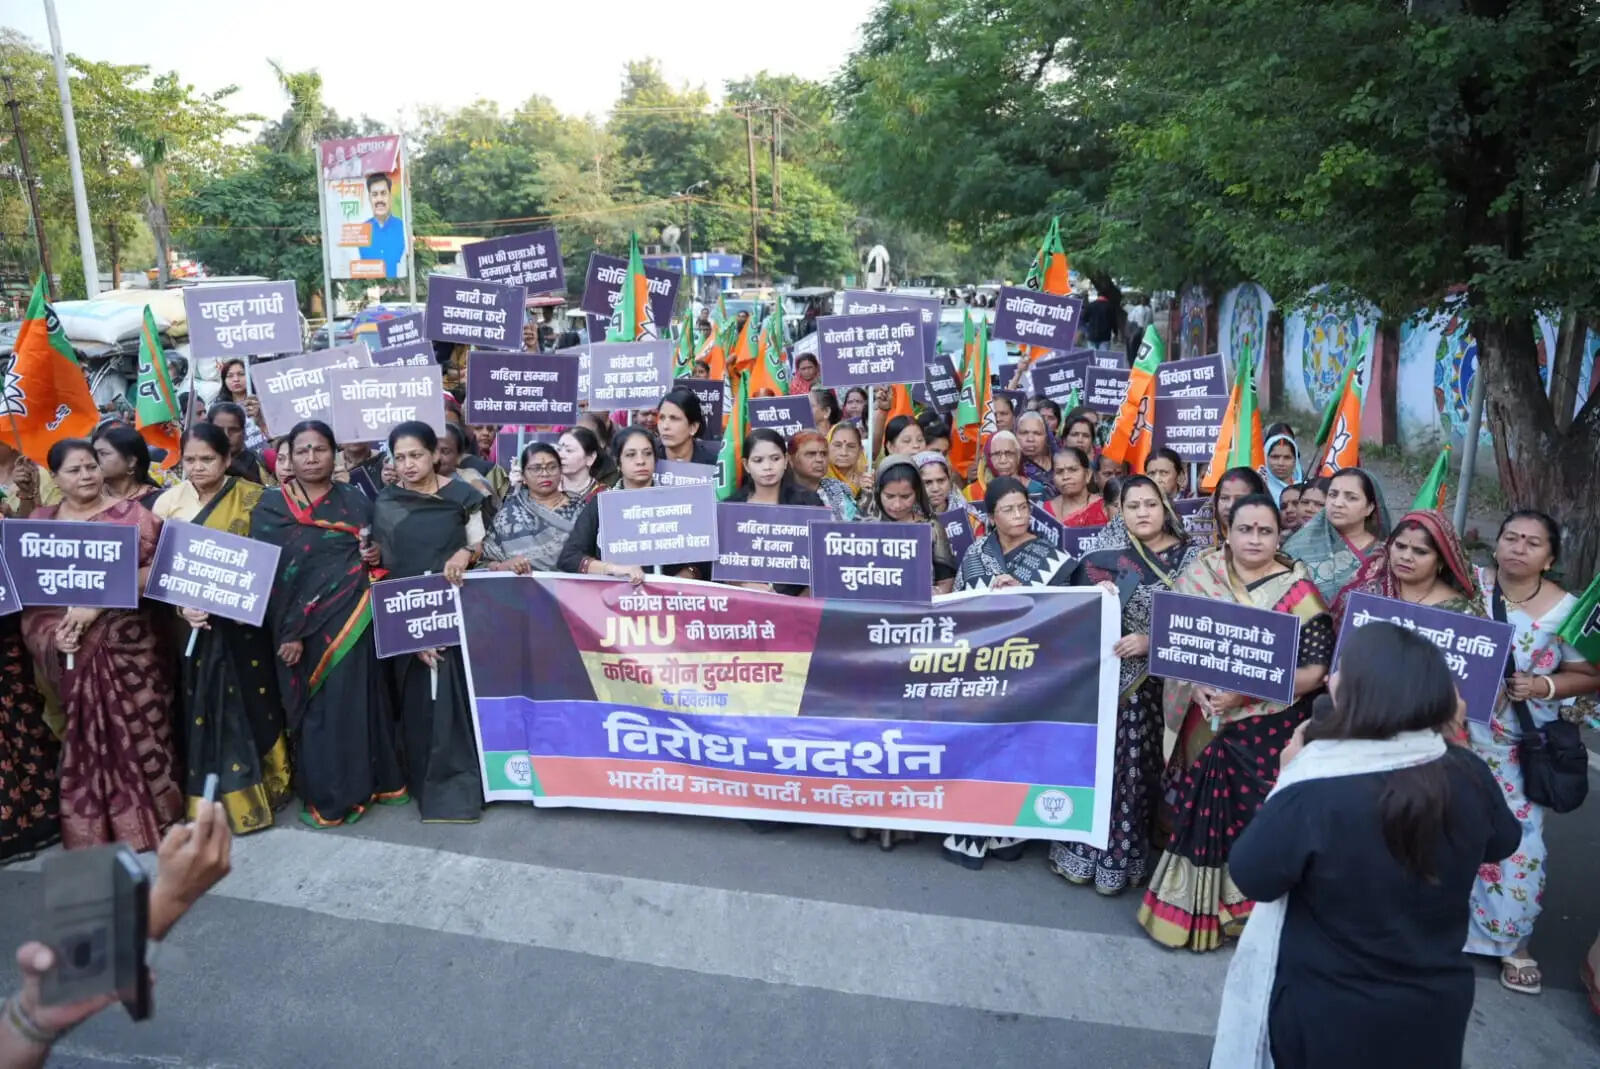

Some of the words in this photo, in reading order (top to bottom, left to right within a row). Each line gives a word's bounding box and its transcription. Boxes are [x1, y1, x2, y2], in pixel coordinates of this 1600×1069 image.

[199, 300, 244, 322] राहुल
[247, 292, 283, 315] गांधी
[456, 289, 480, 304] नारी
[482, 293, 497, 306] का
[1006, 296, 1046, 318] सोनिया
[1047, 304, 1074, 322] गांधी
[442, 305, 483, 321] सम्मान
[485, 308, 507, 324] करो
[214, 320, 275, 348] मुर्दाबाद
[441, 322, 482, 338] सम्मान
[484, 325, 506, 340] करो
[824, 328, 855, 344] बोलती
[856, 326, 865, 341] है
[865, 324, 889, 340] नारी
[891, 323, 916, 339] शक्ति
[1016, 318, 1056, 338] मुर्दाबाद
[837, 347, 853, 359] अब
[854, 342, 876, 357] नहीं
[490, 367, 522, 381] महिला
[523, 371, 559, 382] सम्मान
[848, 360, 870, 375] नहीं
[870, 358, 894, 373] सहेंगे
[1159, 368, 1191, 386] प्रियंका
[1192, 366, 1215, 381] वाड्रा
[266, 367, 324, 394] सोनिया
[341, 378, 397, 401] सोनिया
[399, 376, 433, 398] गांधी
[504, 383, 515, 397] में
[516, 386, 544, 397] हमला
[473, 397, 503, 411] कांग्रेस
[504, 400, 517, 411] का
[519, 398, 548, 412] असली
[549, 399, 573, 412] चेहरा
[756, 406, 778, 421] नारी
[779, 408, 790, 420] का
[1177, 405, 1202, 420] नारी
[1203, 408, 1218, 420] का
[361, 403, 416, 430] मुर्दाबाद
[1165, 425, 1206, 437] सम्मान
[622, 505, 653, 520] महिला
[655, 504, 692, 517] सम्मान
[638, 520, 649, 534] में
[650, 521, 679, 533] हमला
[736, 520, 770, 535] महिला
[771, 524, 809, 537] सम्मान
[19, 532, 81, 560] प्रियंका
[83, 539, 122, 564] वाड्रा
[609, 540, 637, 554] कांग्रेस
[640, 540, 653, 551] का
[654, 535, 685, 550] असली
[687, 534, 710, 547] चेहरा
[752, 536, 764, 551] में
[764, 541, 794, 552] हमला
[825, 532, 879, 558] प्रियंका
[881, 538, 918, 560] वाड्रा
[719, 551, 749, 566] कांग्रेस
[751, 555, 765, 567] का
[766, 555, 798, 569] असली
[37, 564, 106, 595] मुर्दाबाद
[173, 555, 188, 573] के
[188, 560, 238, 587] सम्मान
[239, 571, 256, 590] में
[840, 562, 903, 591] मुर्दाबाद
[159, 574, 202, 599] भाजपा
[203, 582, 241, 608] मैदान
[241, 592, 260, 612] में
[384, 588, 444, 614] सोनिया
[619, 593, 662, 612] कांग्रेस
[666, 592, 706, 612] सांसद
[708, 596, 728, 612] पर
[600, 615, 676, 647] JNU
[685, 620, 705, 640] की
[759, 620, 775, 639] से
[867, 617, 936, 644] बोलती
[939, 616, 957, 644] है
[1169, 614, 1193, 630] JNU
[1196, 616, 1213, 633] की
[1261, 628, 1276, 646] के
[909, 639, 972, 673] नारी
[974, 637, 1040, 671] शक्ति
[1168, 631, 1216, 652] सम्मान
[1217, 638, 1232, 655] में
[1233, 644, 1274, 664] भाजपा
[1456, 635, 1498, 658] शक्ति
[601, 658, 653, 684] कथित
[658, 657, 699, 684] यौन
[702, 656, 784, 690] दुर्व्यवहार
[1157, 647, 1199, 666] महिला
[1200, 653, 1230, 673] मोर्चा
[1230, 659, 1267, 681] मैदान
[1269, 667, 1285, 685] में
[660, 689, 674, 706] के
[903, 682, 928, 699] अब
[930, 677, 963, 698] नहीं
[962, 676, 999, 697] सहेंगे
[602, 711, 946, 776] विरोध-प्रदर्शन
[607, 767, 685, 792] भारतीय
[688, 775, 749, 797] जनता
[811, 784, 884, 808] महिला
[889, 785, 945, 809] मोर्चा
